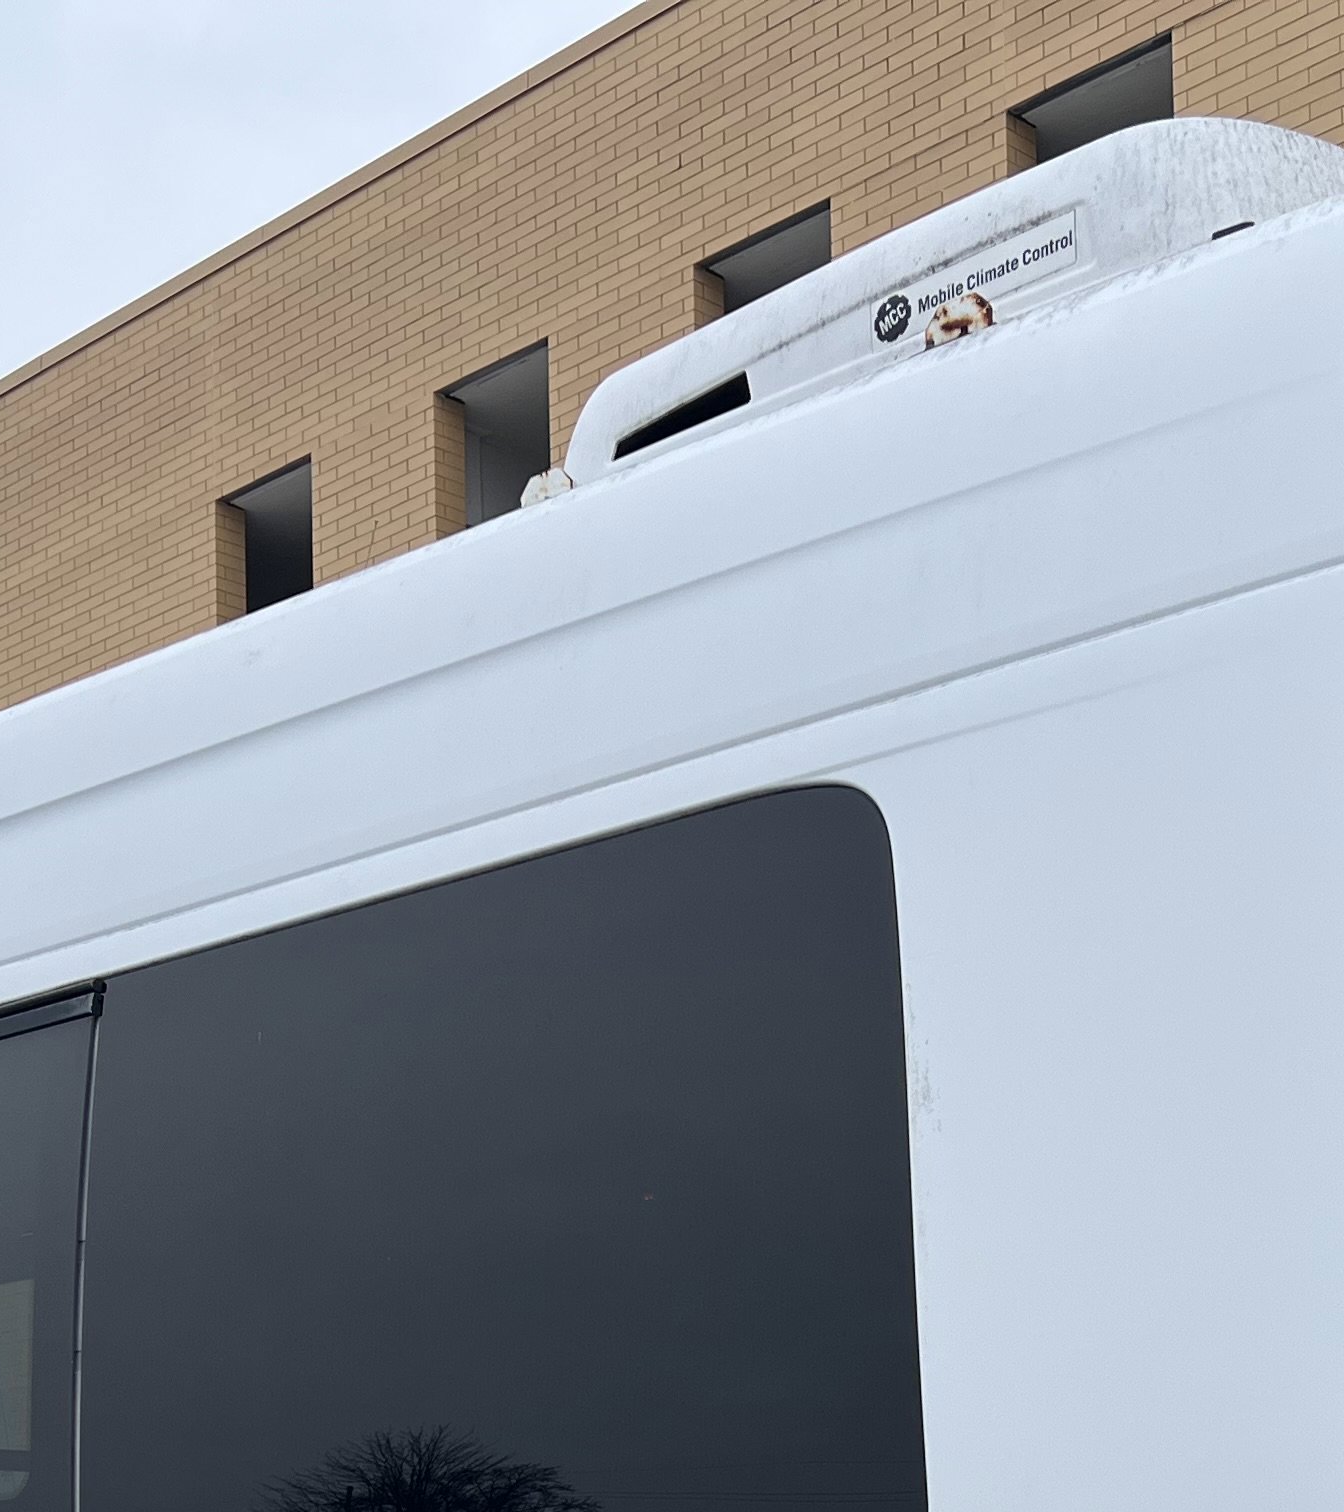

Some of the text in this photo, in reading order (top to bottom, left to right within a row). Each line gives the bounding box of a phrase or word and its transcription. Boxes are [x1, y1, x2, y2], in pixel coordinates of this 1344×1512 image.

[918, 231, 1073, 314] Mobile Climate Control
[878, 302, 907, 336] MCC
